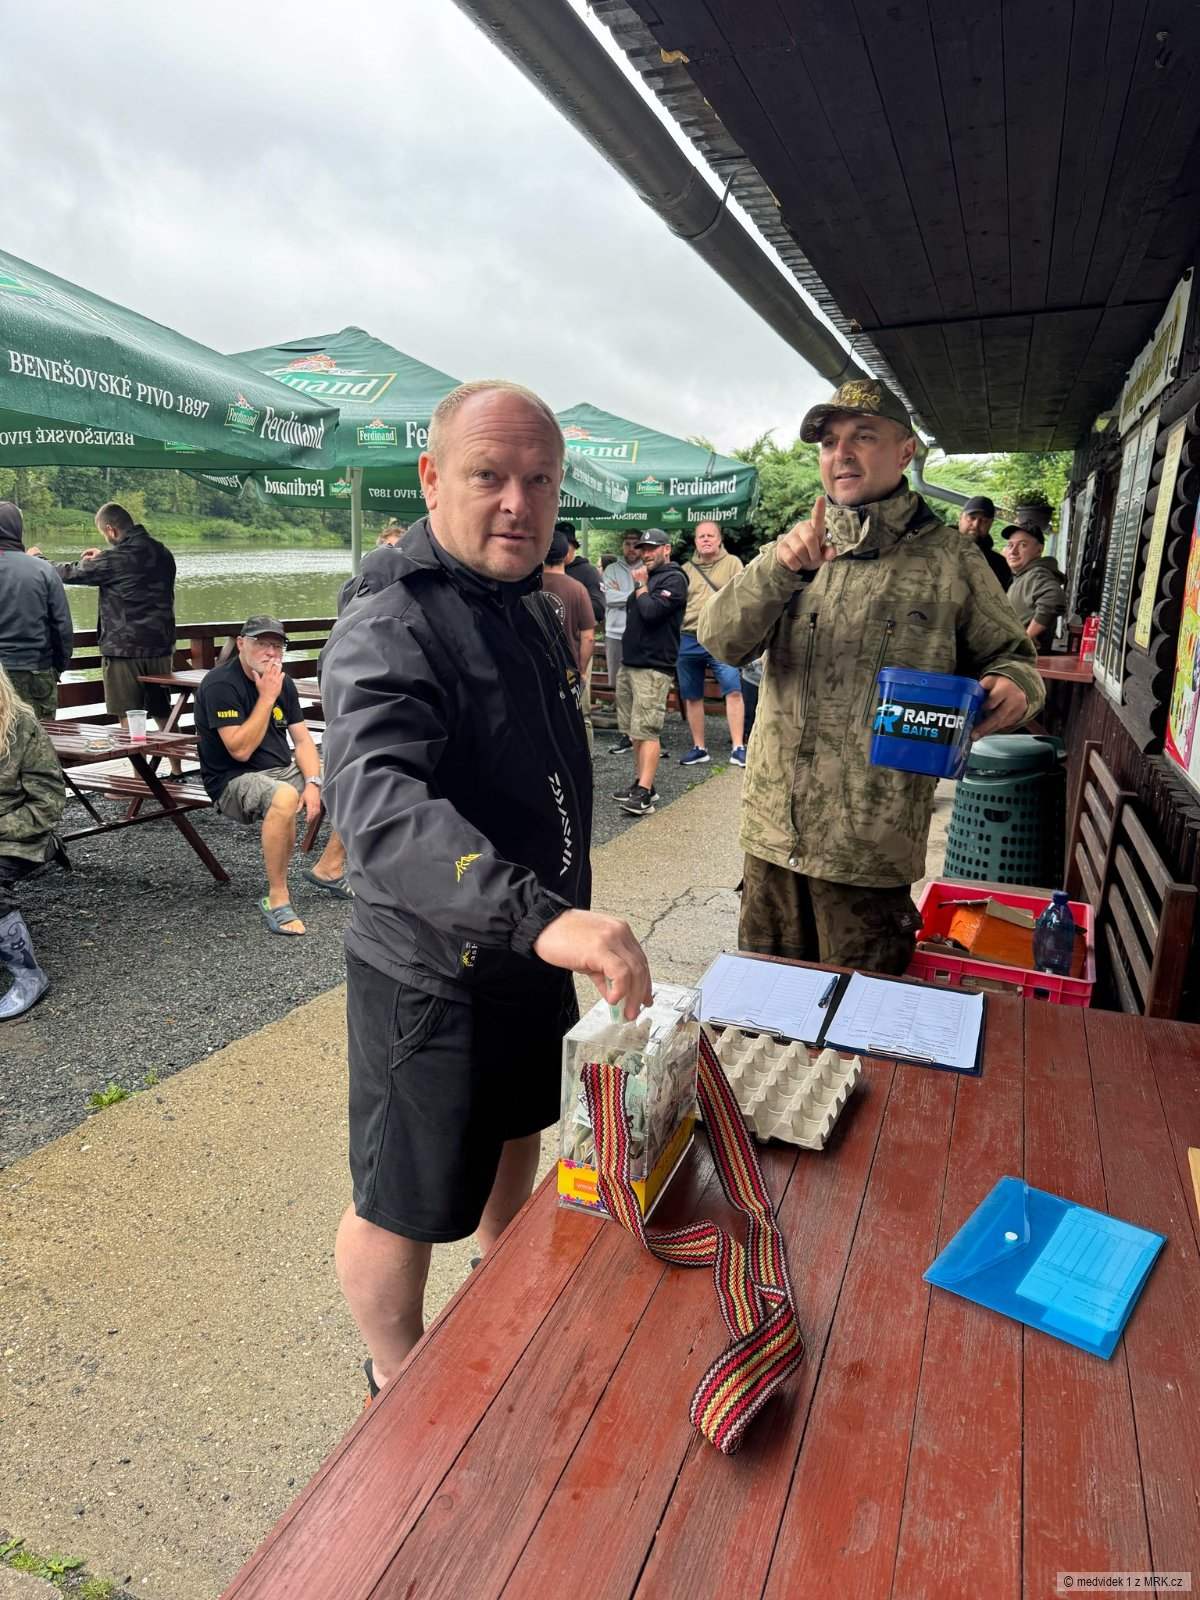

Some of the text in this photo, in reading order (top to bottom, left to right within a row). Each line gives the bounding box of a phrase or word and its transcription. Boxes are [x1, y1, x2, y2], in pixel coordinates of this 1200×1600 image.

[8, 350, 210, 419] BENEŠOVSKÉ PIVO 1897
[228, 407, 258, 426] Ferdinand
[260, 406, 325, 449] Ferdinand
[360, 430, 395, 441] Ferdinand
[669, 474, 737, 496] Ferdinand
[903, 708, 965, 730] RAPTOR
[901, 724, 940, 738] BAITS
